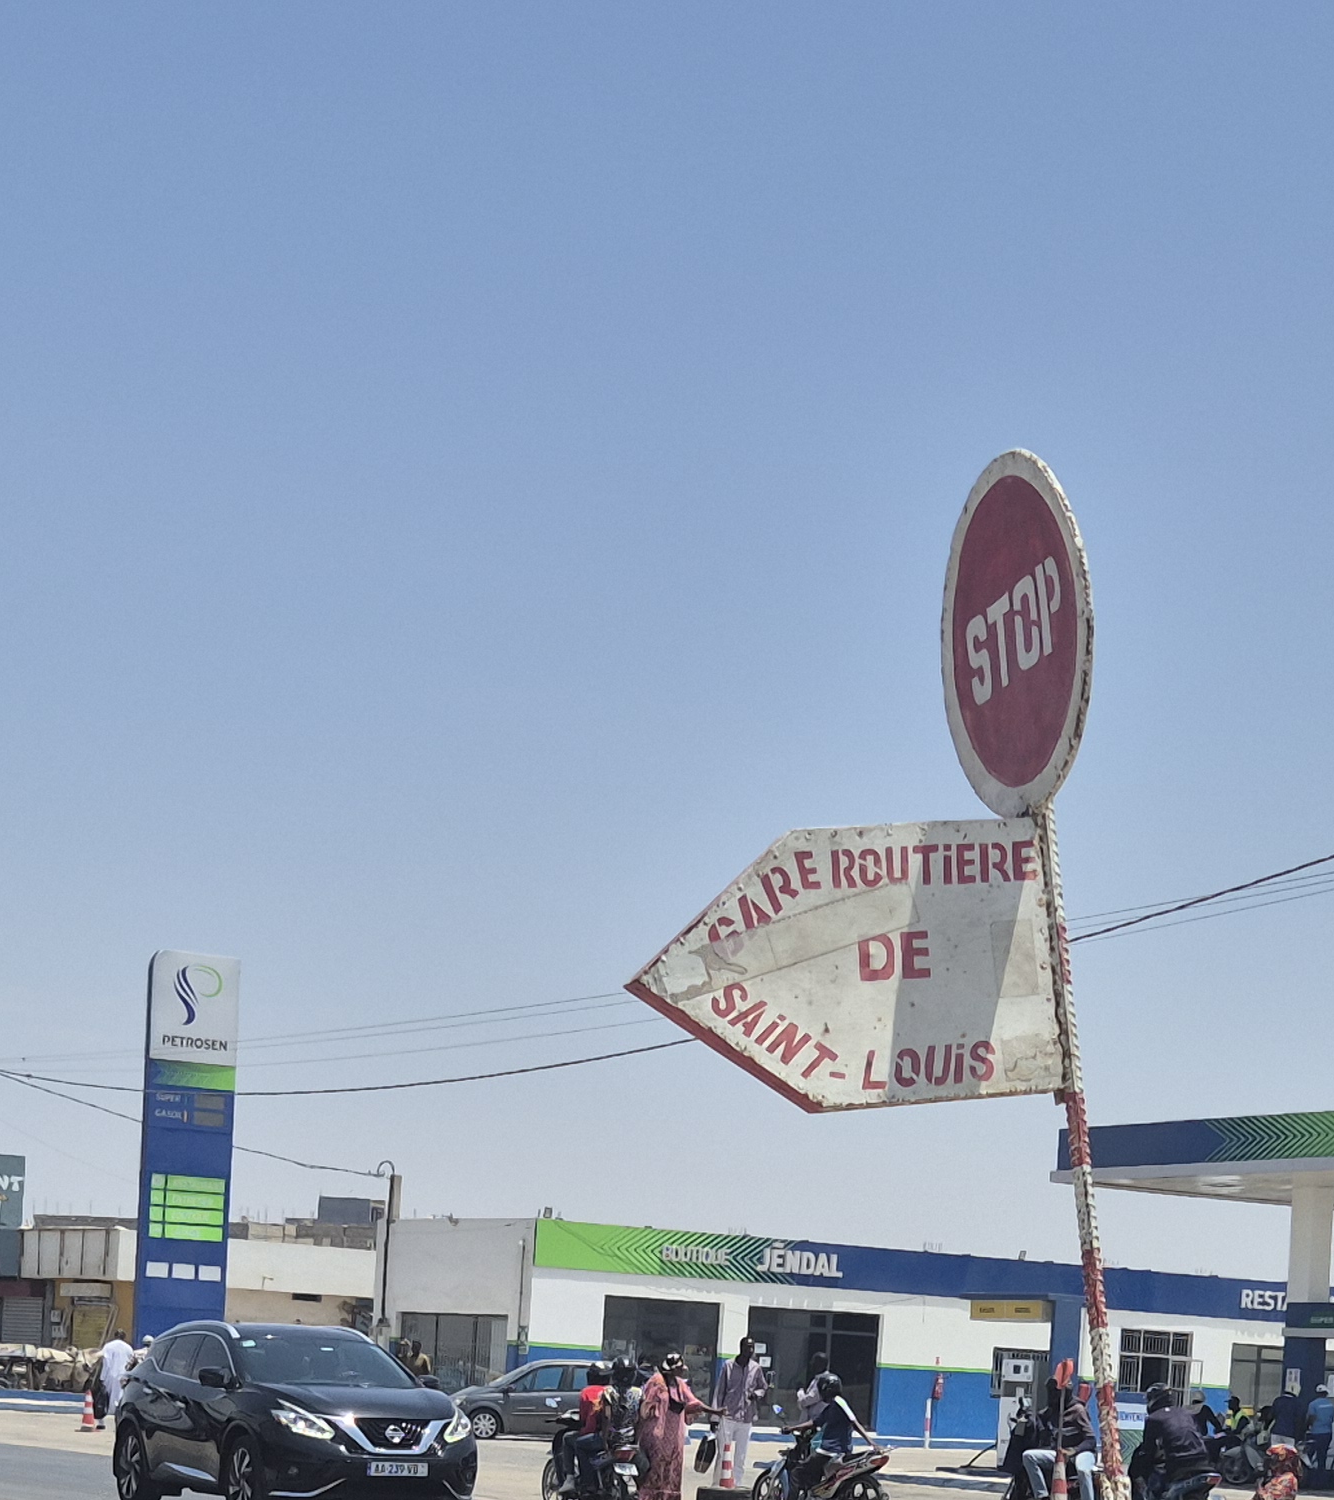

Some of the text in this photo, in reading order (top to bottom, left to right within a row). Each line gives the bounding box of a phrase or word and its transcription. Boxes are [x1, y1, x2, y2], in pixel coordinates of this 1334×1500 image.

[965, 556, 1061, 706] STOP
[707, 850, 822, 957] GARE
[857, 930, 931, 981] DE
[161, 1034, 228, 1051] PETROSEN
[661, 1246, 732, 1266] BOUTIQUE
